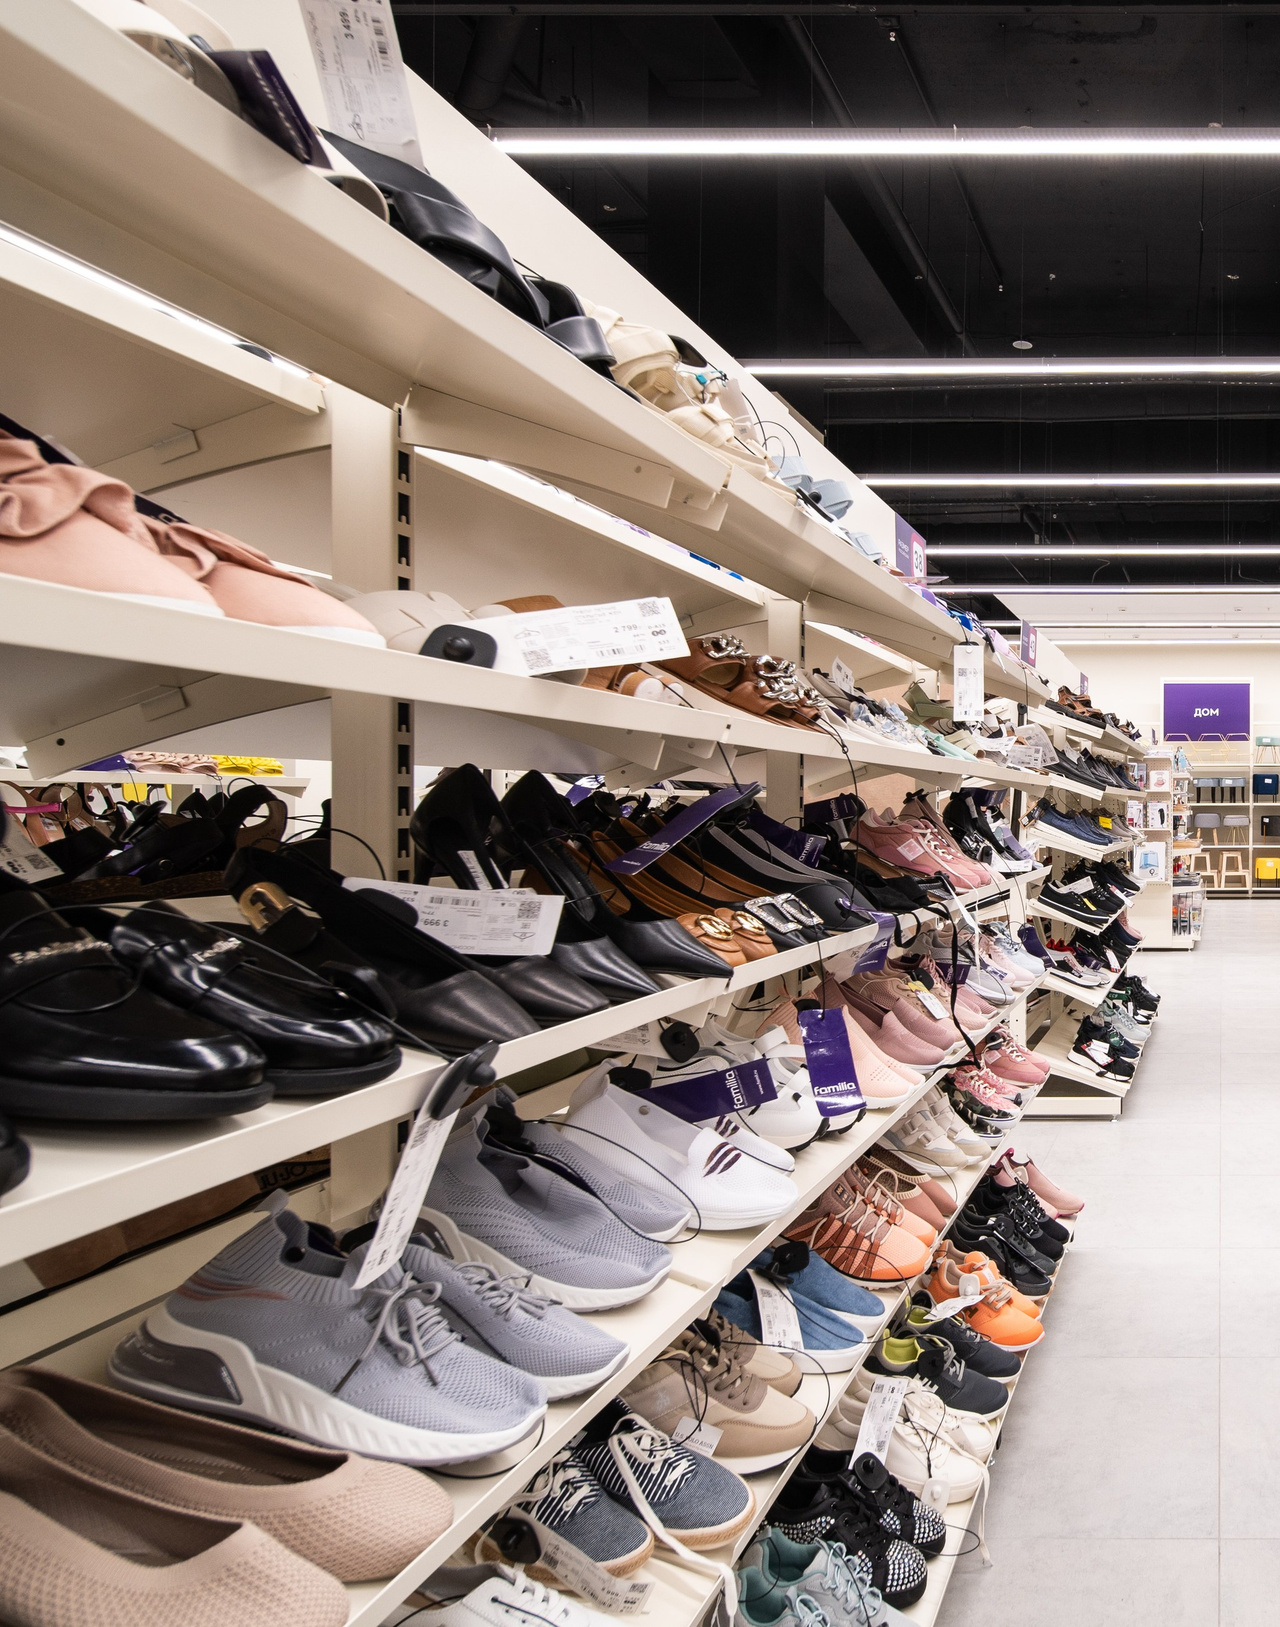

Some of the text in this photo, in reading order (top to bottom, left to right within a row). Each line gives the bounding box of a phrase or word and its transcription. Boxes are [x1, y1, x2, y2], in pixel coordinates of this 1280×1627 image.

[914, 550, 924, 574] 38
[1193, 707, 1220, 718] ДОМ
[798, 837, 814, 861] amilia
[423, 918, 441, 927] 999
[725, 1070, 745, 1110] familia
[814, 1081, 857, 1096] familia
